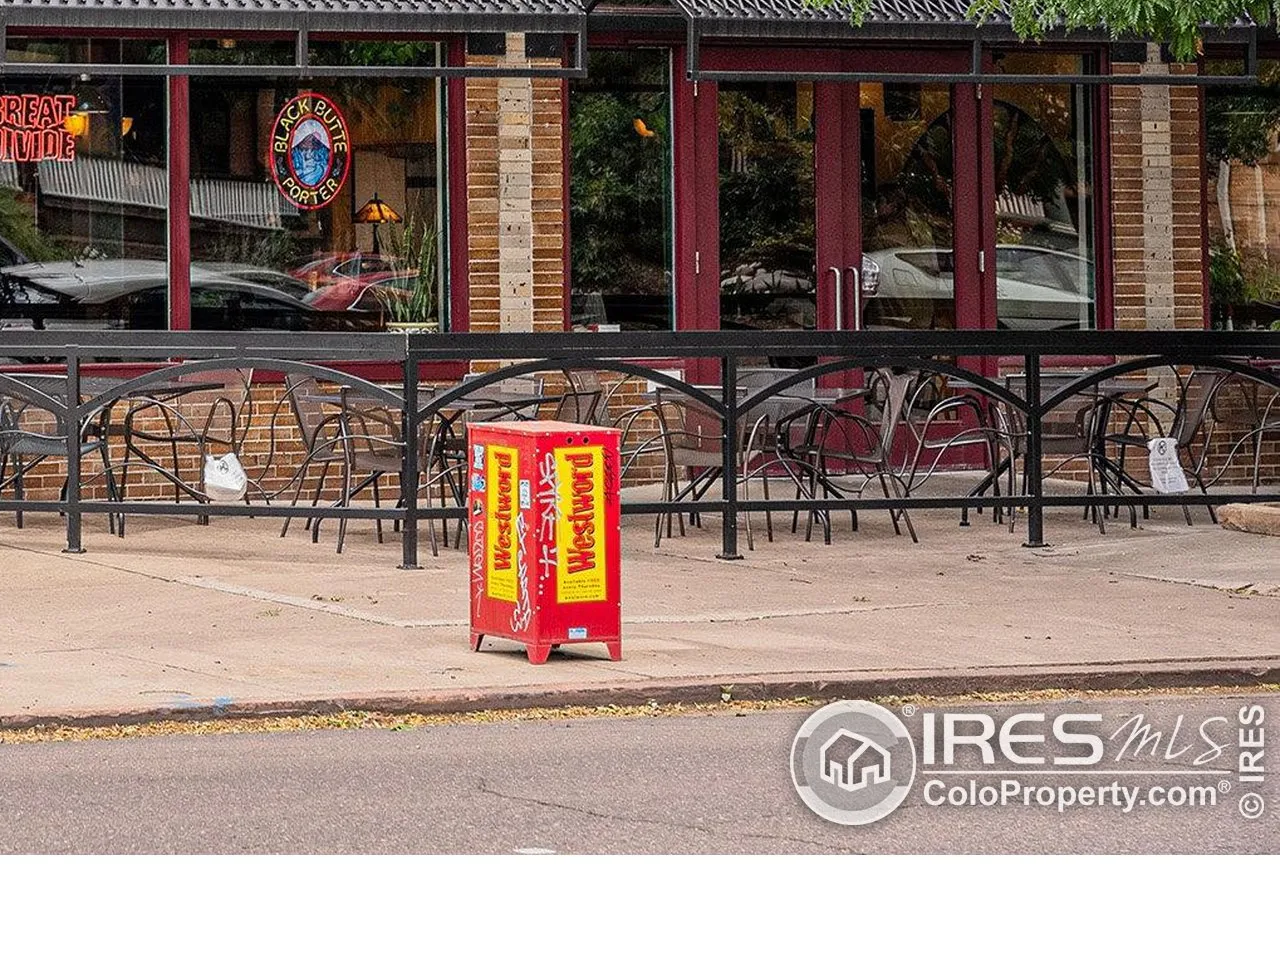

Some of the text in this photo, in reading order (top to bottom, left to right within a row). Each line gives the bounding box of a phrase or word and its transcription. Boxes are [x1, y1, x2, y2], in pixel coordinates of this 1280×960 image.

[274, 98, 348, 153] BLACK BUTTE
[282, 177, 339, 204] PORTER
[494, 451, 513, 571] Westword
[567, 452, 594, 574] Westword
